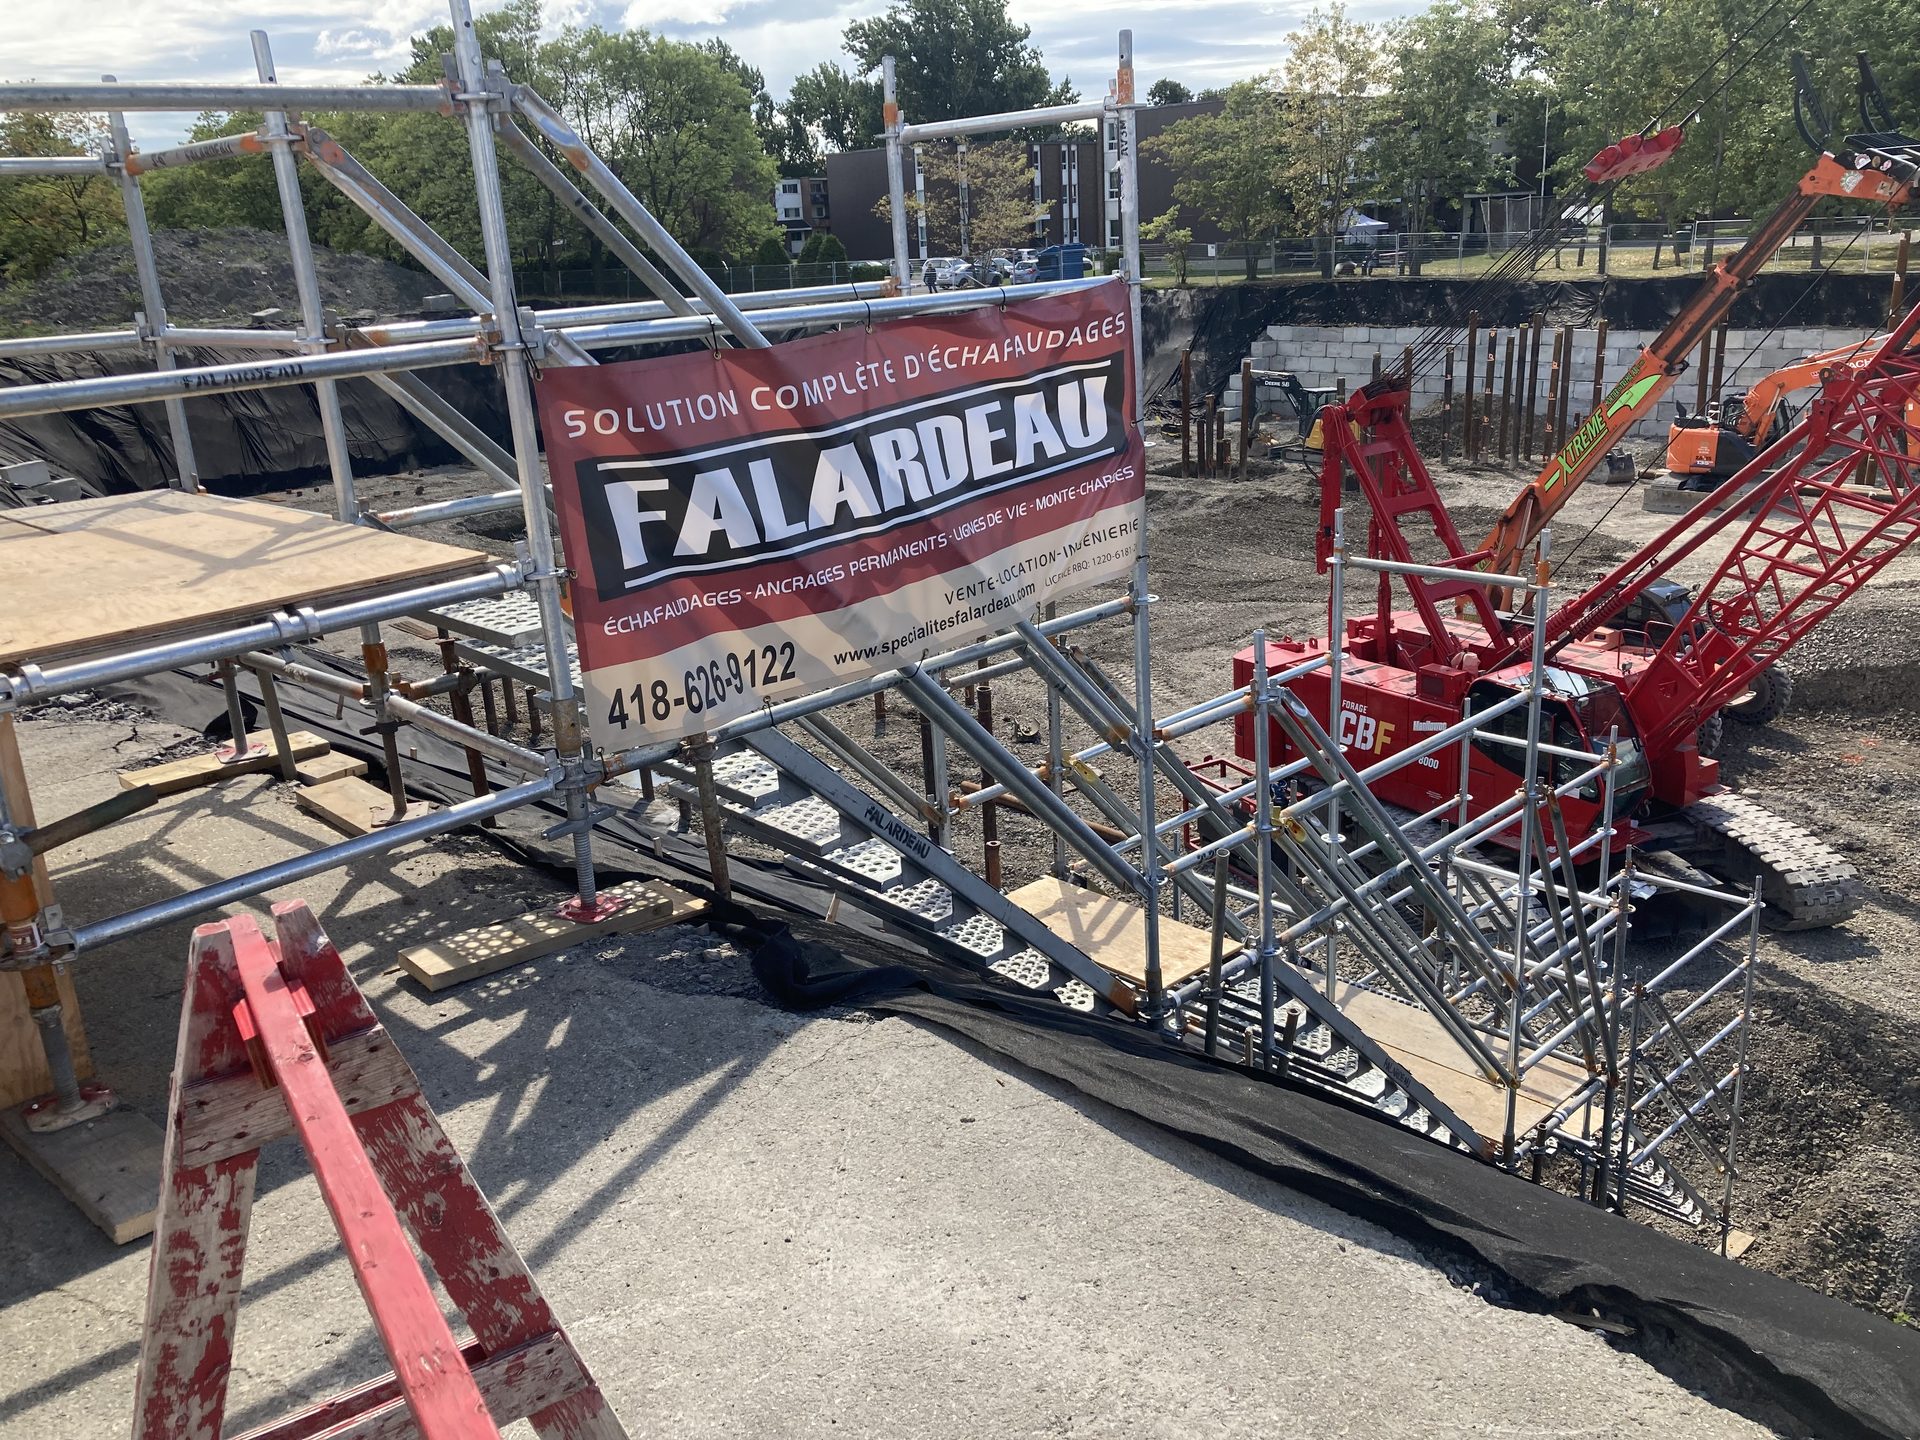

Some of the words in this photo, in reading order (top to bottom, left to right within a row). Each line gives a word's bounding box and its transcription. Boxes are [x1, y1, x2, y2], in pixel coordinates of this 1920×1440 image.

[181, 363, 304, 389] FALARDEAU
[564, 389, 739, 438] SOLUTION
[750, 360, 896, 411] COMPLÈTE
[904, 311, 1126, 380] D'ÉCHAFAUDAGES
[603, 375, 1108, 570] FALARDEAU
[1557, 407, 1608, 487] XTREME
[603, 588, 742, 636] ÉCHAFAUDAGES
[754, 564, 846, 600] ANCRAGES
[849, 532, 948, 577] PERMANENTS
[952, 516, 987, 541] LIGNES
[987, 510, 1003, 528] DE
[1006, 502, 1028, 521] VIE
[1072, 559, 1091, 574] RBQ:
[834, 581, 1036, 665] www.specialitesfalardeau.com
[608, 641, 796, 730] 418-626-9122
[1341, 699, 1368, 714] FORAGE
[1339, 710, 1396, 755] CBF
[863, 805, 931, 859] FALARDEAU
